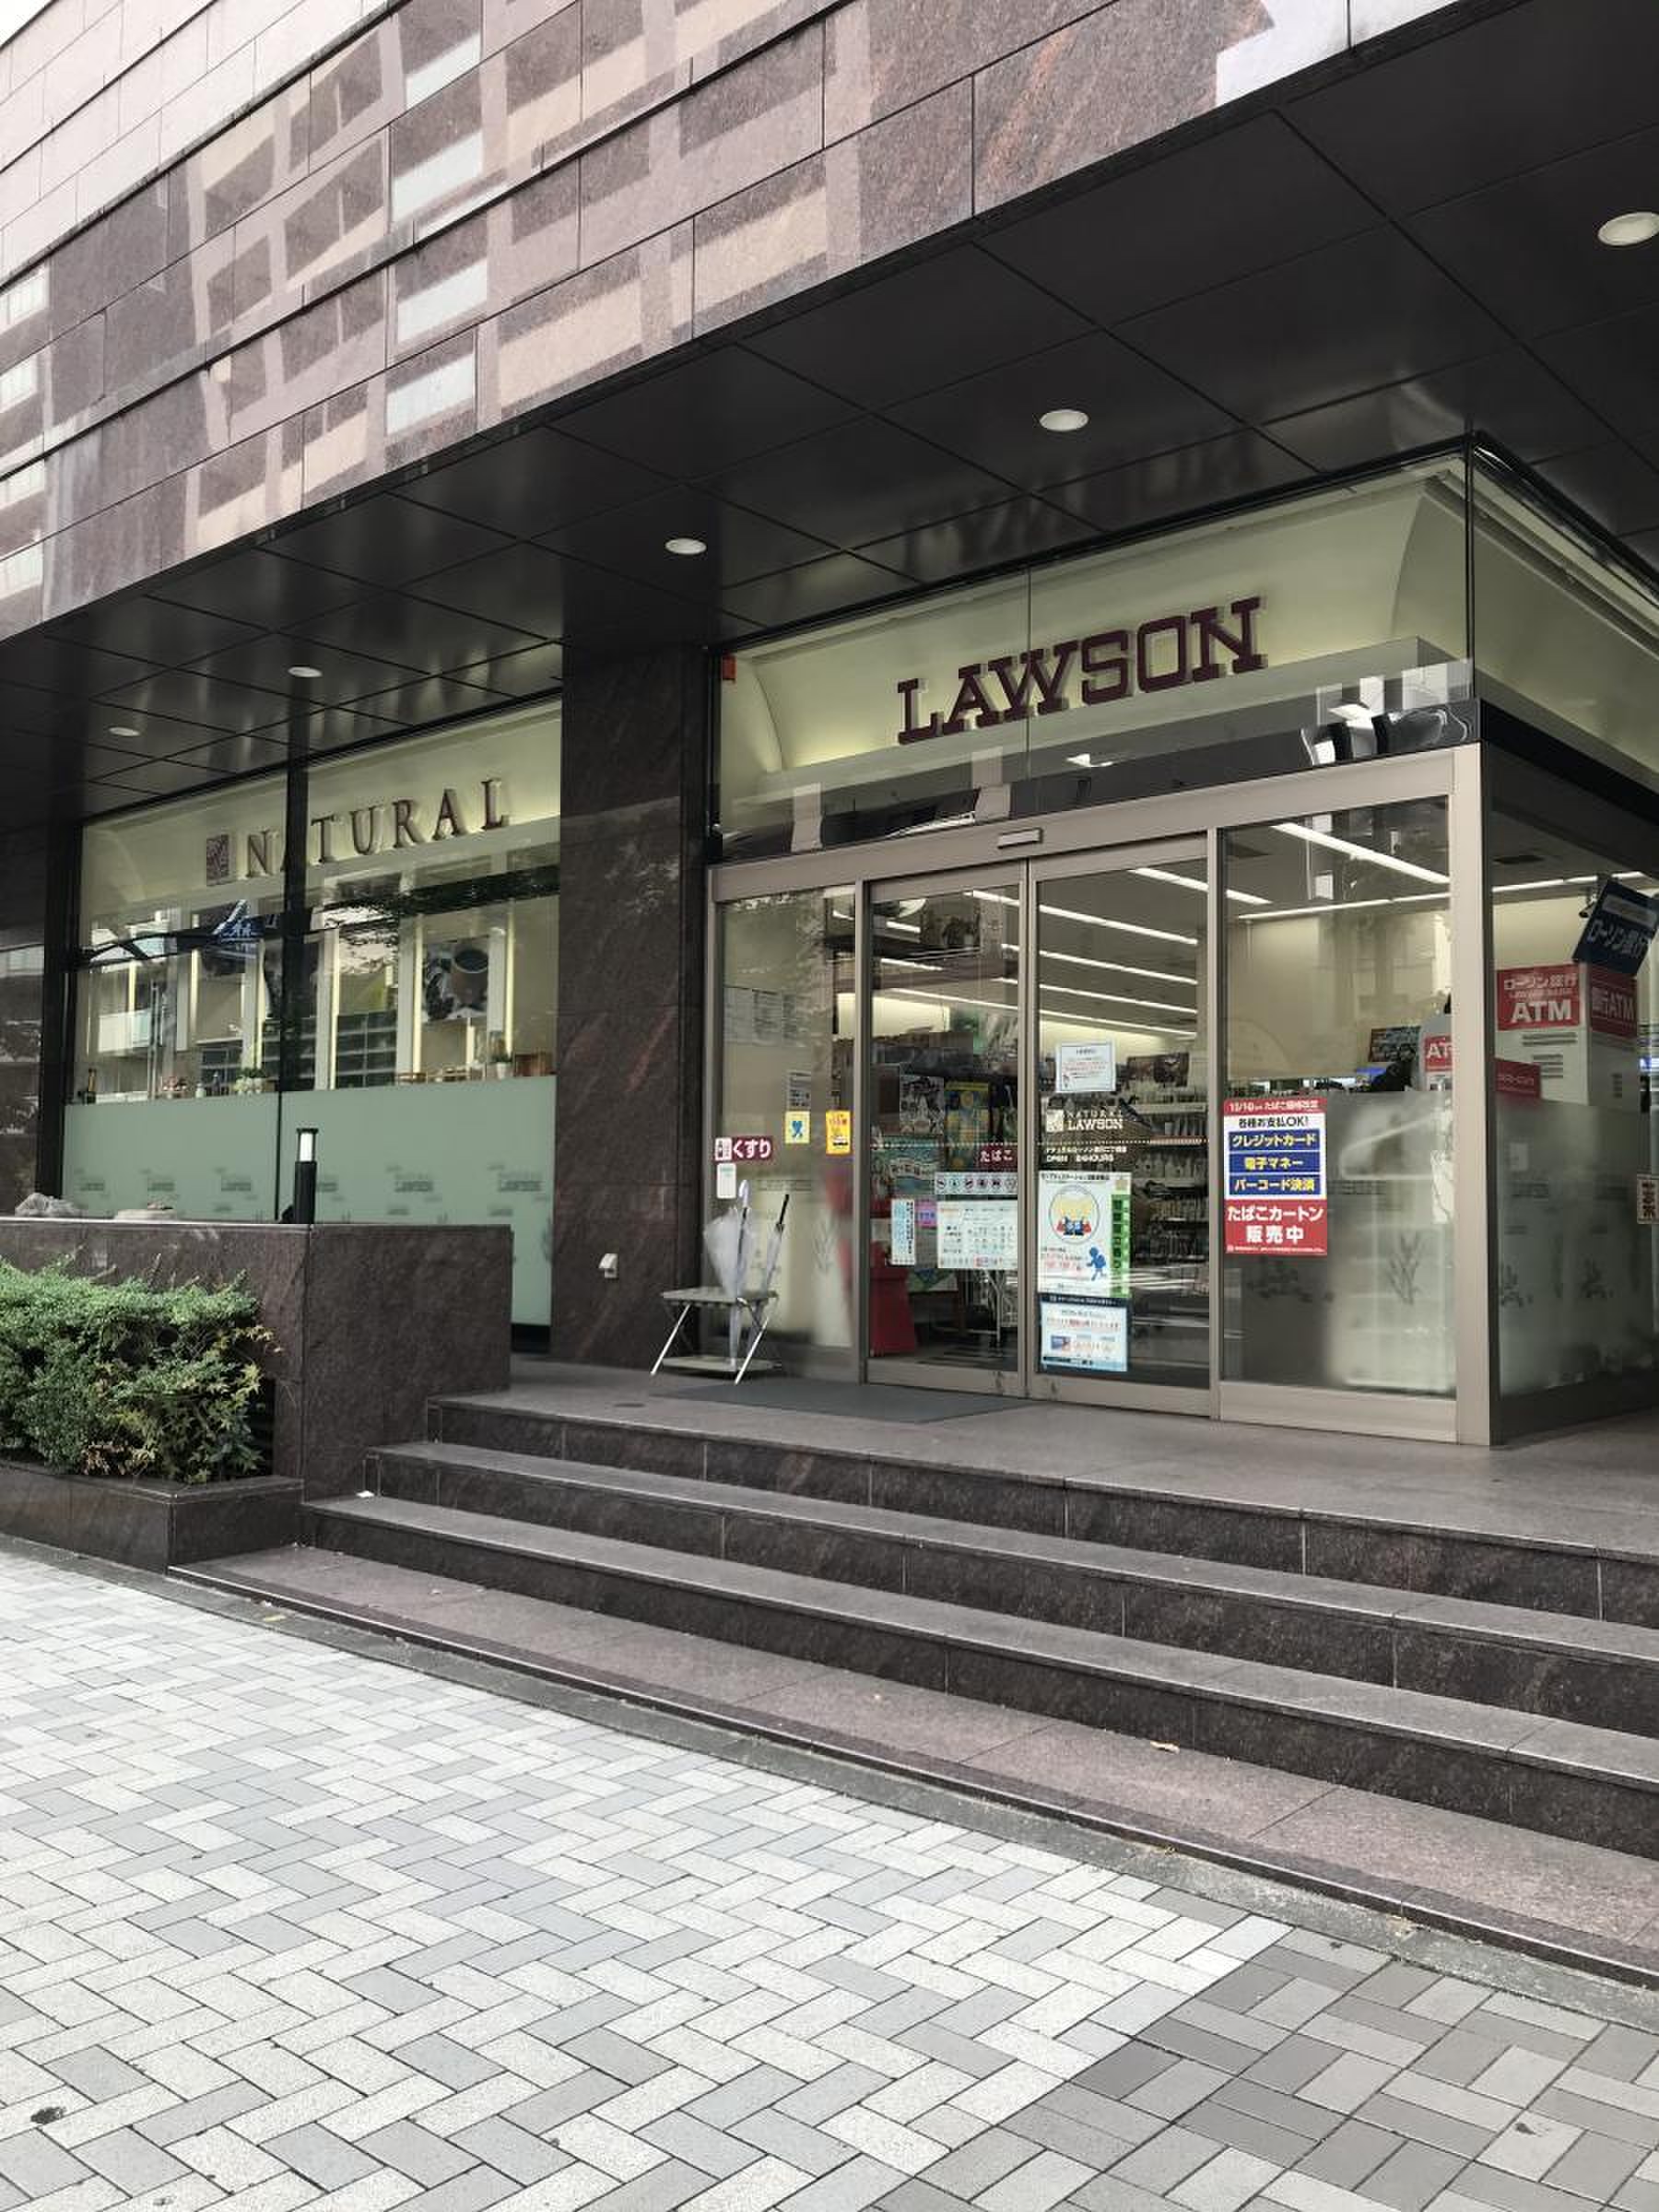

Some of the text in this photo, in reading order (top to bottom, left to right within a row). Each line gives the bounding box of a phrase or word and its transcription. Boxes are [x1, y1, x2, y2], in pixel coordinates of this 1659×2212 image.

[897, 595, 1268, 746] LAWSON
[245, 777, 510, 878] NTURAL
[1503, 973, 1578, 990] ローソン銀行
[1510, 998, 1572, 1024] ATM
[1427, 1041, 1453, 1059] AT
[1067, 1118, 1124, 1131] LAWSON
[733, 1137, 771, 1159] くすり
[1232, 1133, 1316, 1148] クレジットカード
[1244, 1157, 1304, 1171] 電子マネー
[1227, 1204, 1324, 1222] たばこカートン
[1245, 1225, 1304, 1245] 販売中
